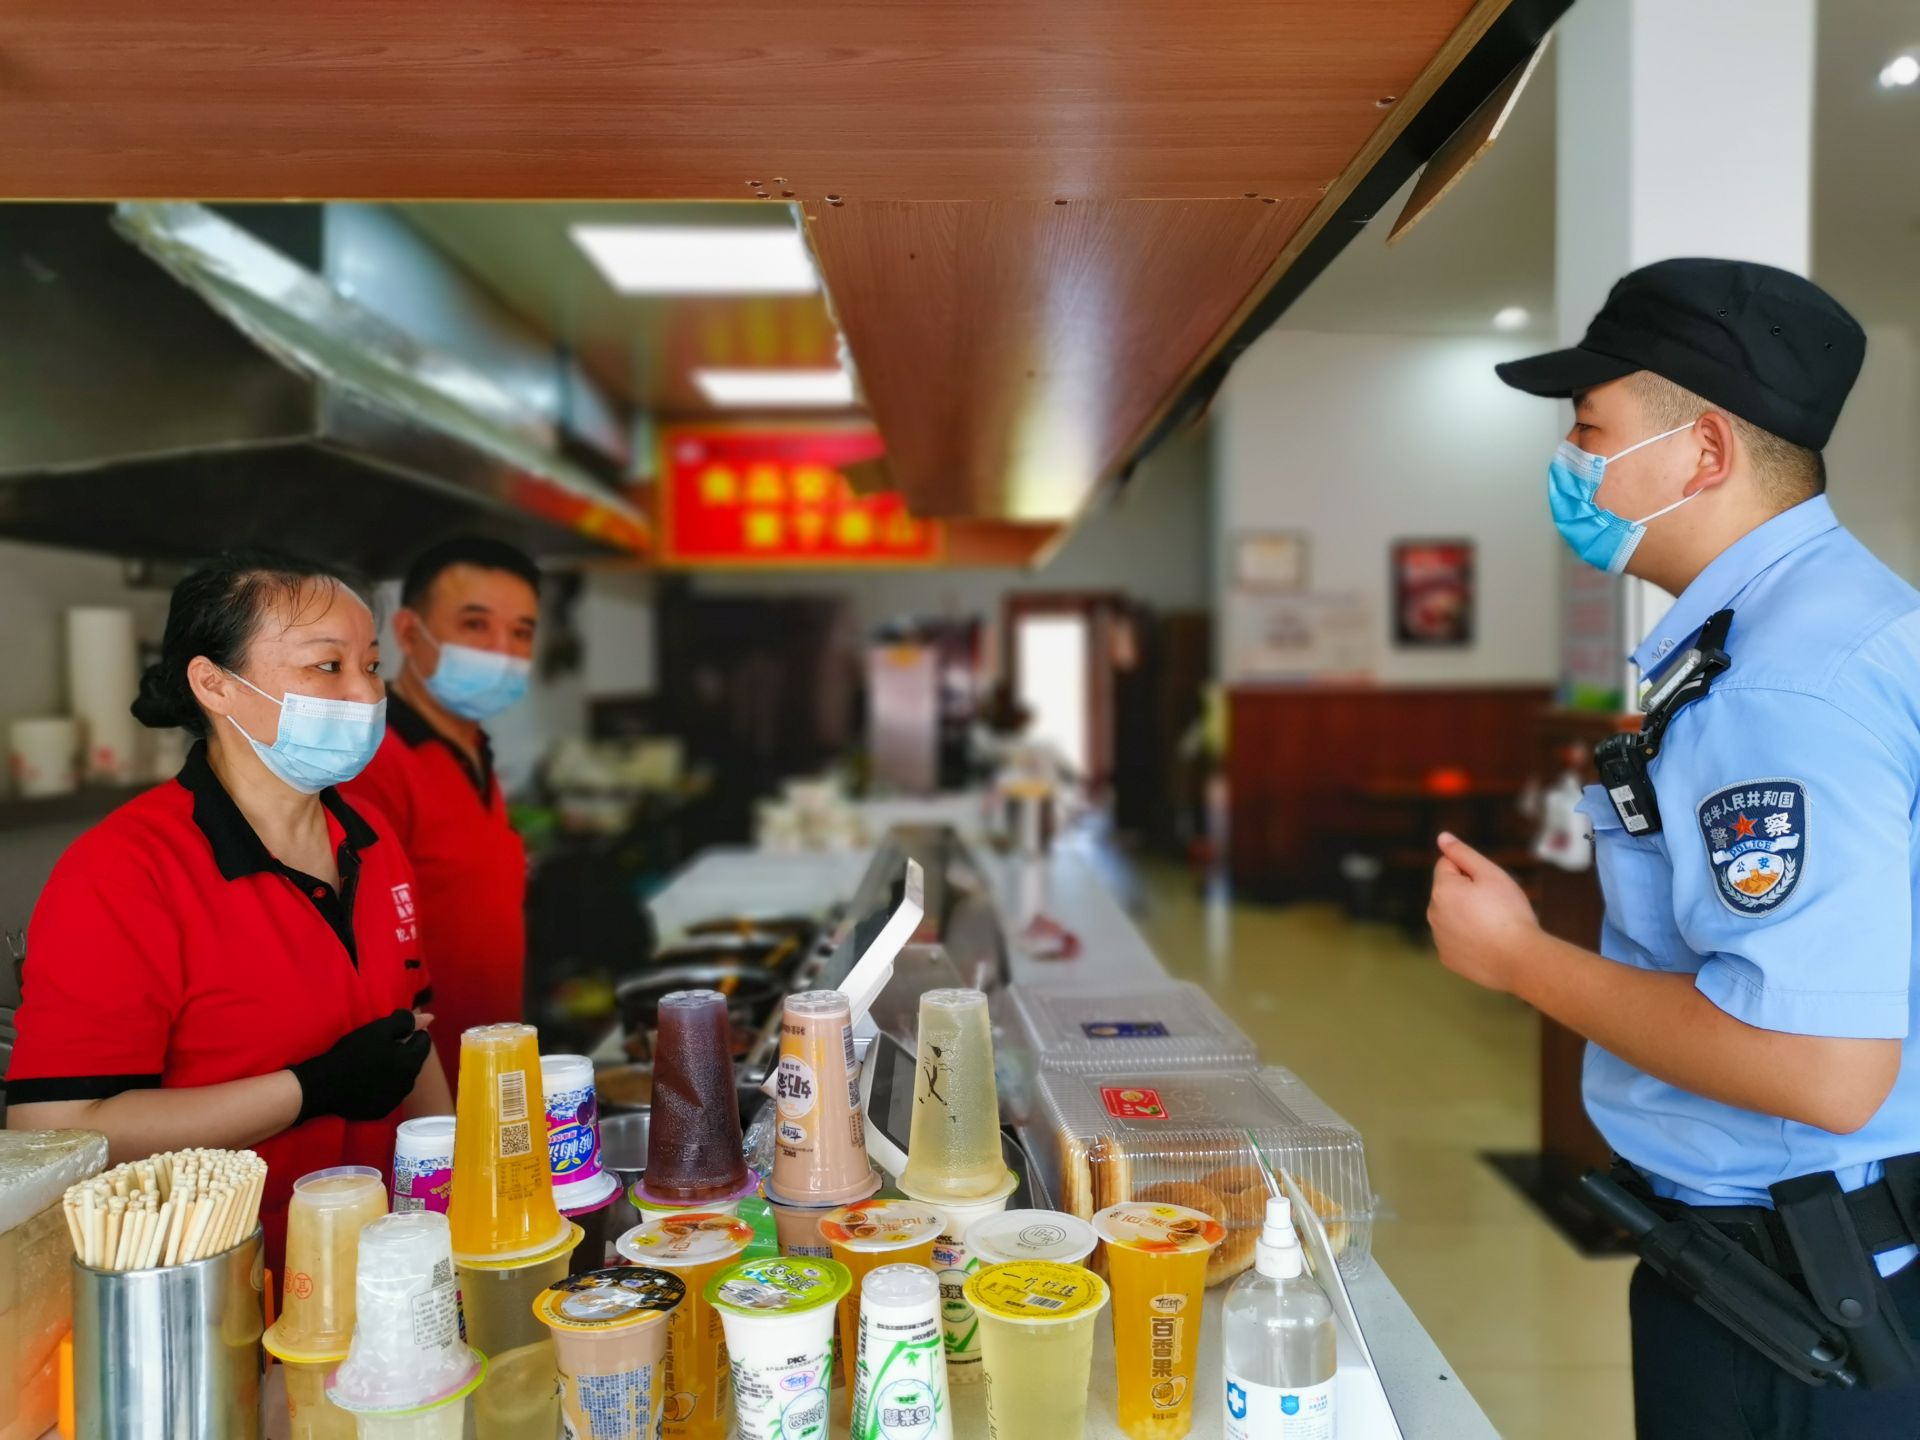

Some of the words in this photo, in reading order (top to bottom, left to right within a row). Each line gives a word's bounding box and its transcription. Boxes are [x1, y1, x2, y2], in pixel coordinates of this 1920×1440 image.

[1703, 790, 1795, 827] 中华人民共和国
[1710, 827, 1729, 849] 警
[1763, 812, 1792, 837] 察
[1729, 840, 1773, 859] POLICE
[939, 1284, 964, 1299] 西米
[1152, 1317, 1174, 1378] 百香果
[787, 1354, 808, 1365] PICC
[883, 1406, 930, 1427] 西米露
